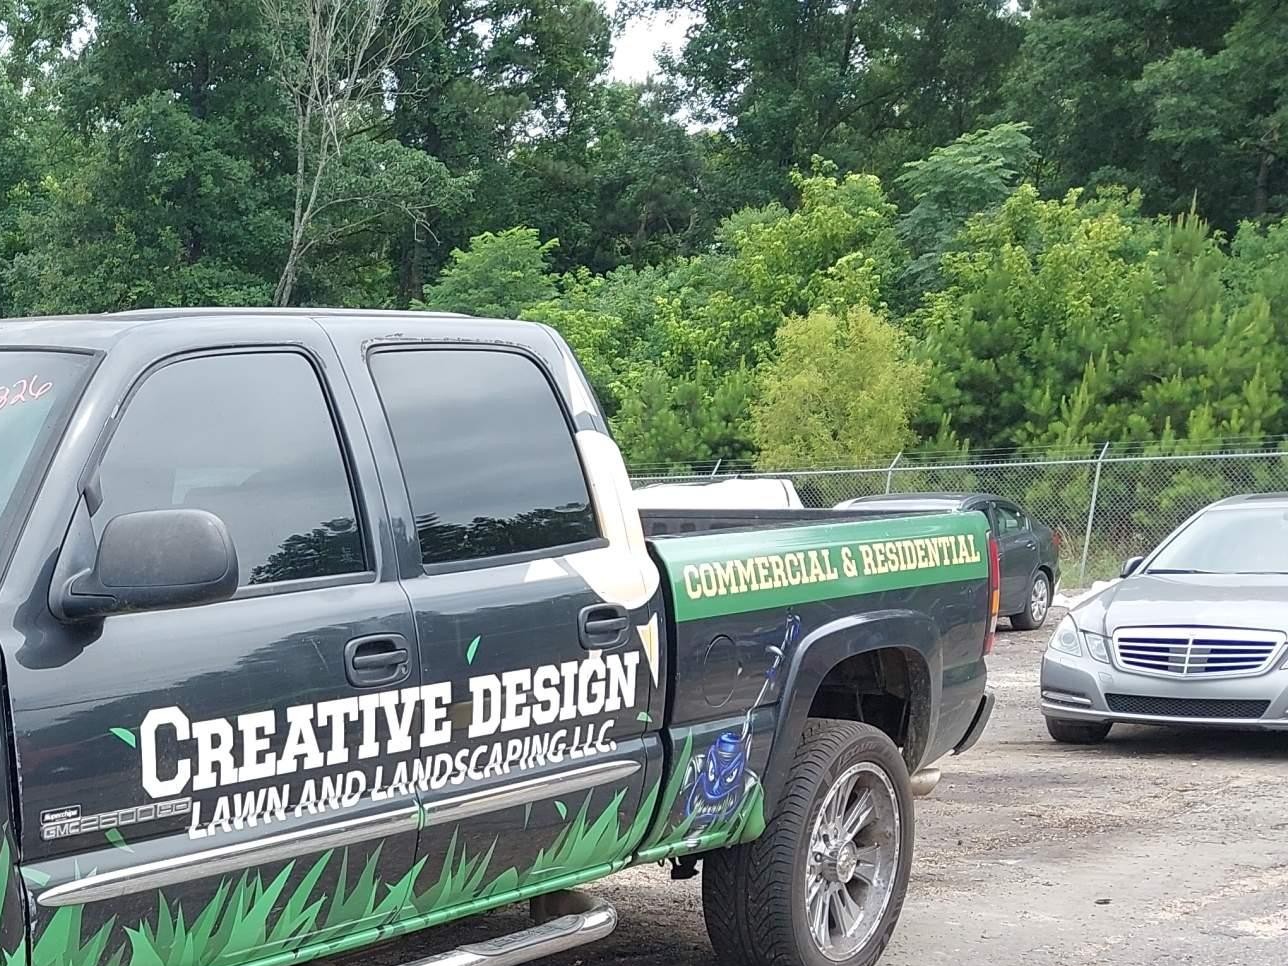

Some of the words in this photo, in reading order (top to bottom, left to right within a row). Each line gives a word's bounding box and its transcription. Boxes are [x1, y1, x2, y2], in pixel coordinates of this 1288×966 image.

[683, 549, 838, 599] COMMERCIAL
[841, 546, 857, 578] &
[860, 534, 980, 575] RESIDENTIAL
[139, 682, 452, 798] CREATIVE
[469, 651, 640, 738] DESIGN
[188, 786, 290, 840] LAWN
[300, 772, 367, 818] AND
[371, 729, 567, 800] LANDSCAPING
[43, 821, 81, 840] GMC
